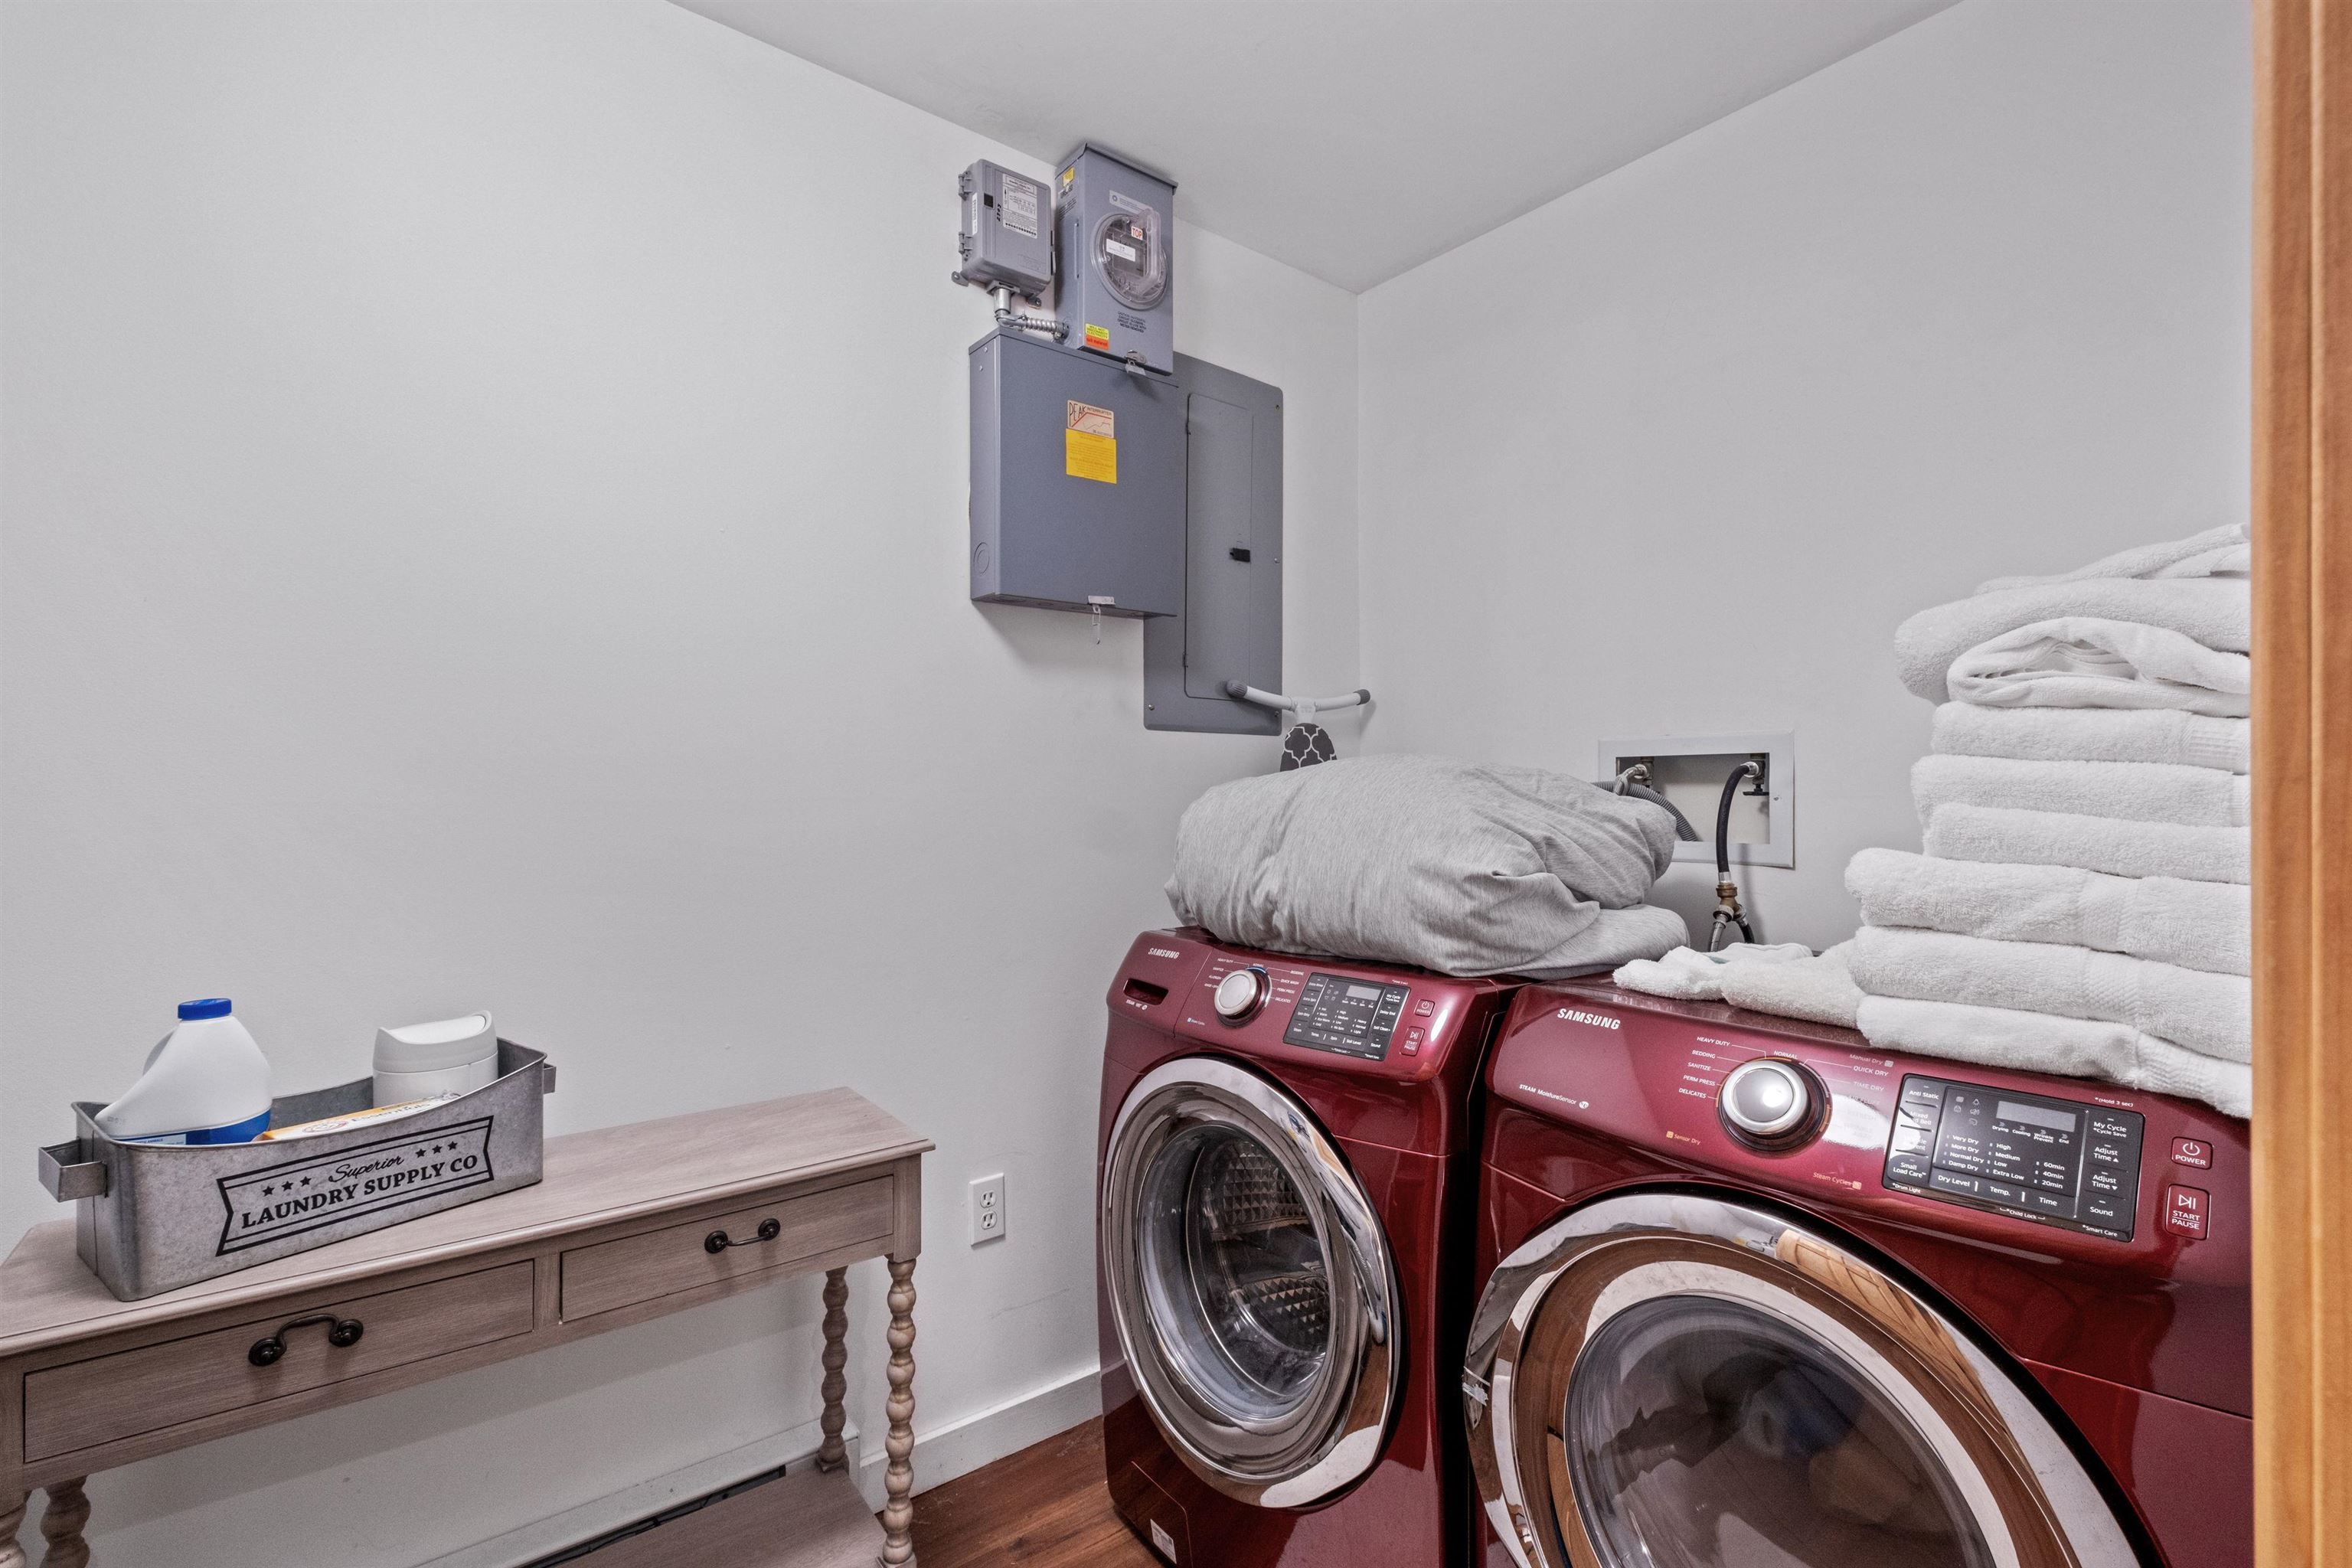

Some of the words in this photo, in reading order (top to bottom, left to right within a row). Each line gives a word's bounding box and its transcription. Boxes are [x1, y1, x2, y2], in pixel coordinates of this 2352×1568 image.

[1132, 227, 1142, 239] TOP
[1070, 403, 1087, 427] PEAK
[1148, 947, 1180, 959] SAMSUNG
[1557, 1008, 1621, 1030] SAMSUNG
[1692, 1050, 1716, 1060] BEDDING
[1773, 1050, 1798, 1060] NORMAL
[1850, 1054, 1870, 1063] Manual
[1687, 1062, 1711, 1071] SANITIZE
[1699, 1078, 1716, 1086] PRESS
[1519, 1084, 1536, 1093] STEAM
[1678, 1088, 1707, 1099] DELICATES
[2093, 1122, 2105, 1130] My
[2107, 1124, 2127, 1132] Cycle
[1952, 1135, 1966, 1144] Very
[2094, 1147, 2118, 1156] Adjust
[1949, 1152, 1971, 1161] Normal
[1995, 1152, 2020, 1161] Medium
[2094, 1153, 2112, 1161] Time
[2175, 1155, 2206, 1165] POWER
[328, 1155, 404, 1183] Superior
[1949, 1161, 1966, 1169] Damp
[2043, 1162, 2065, 1171] 60min
[1993, 1169, 2010, 1178] Extra
[2043, 1171, 2064, 1180] 40min
[1813, 1172, 1831, 1181] Steam
[1832, 1176, 1851, 1186] Cycles
[1952, 1178, 1971, 1187] Level
[2092, 1174, 2117, 1184] Adjust
[2041, 1180, 2063, 1189] 20min
[2092, 1181, 2110, 1190] Time
[242, 1184, 358, 1229] LAUNDRY
[363, 1161, 446, 1196] SUPPLY
[450, 1155, 479, 1172] CO
[1990, 1187, 2011, 1196] Temp.
[2039, 1197, 2057, 1206] Time
[2089, 1207, 2113, 1217] Sound
[2173, 1210, 2200, 1220] START
[2171, 1219, 2200, 1230] PAUSE
